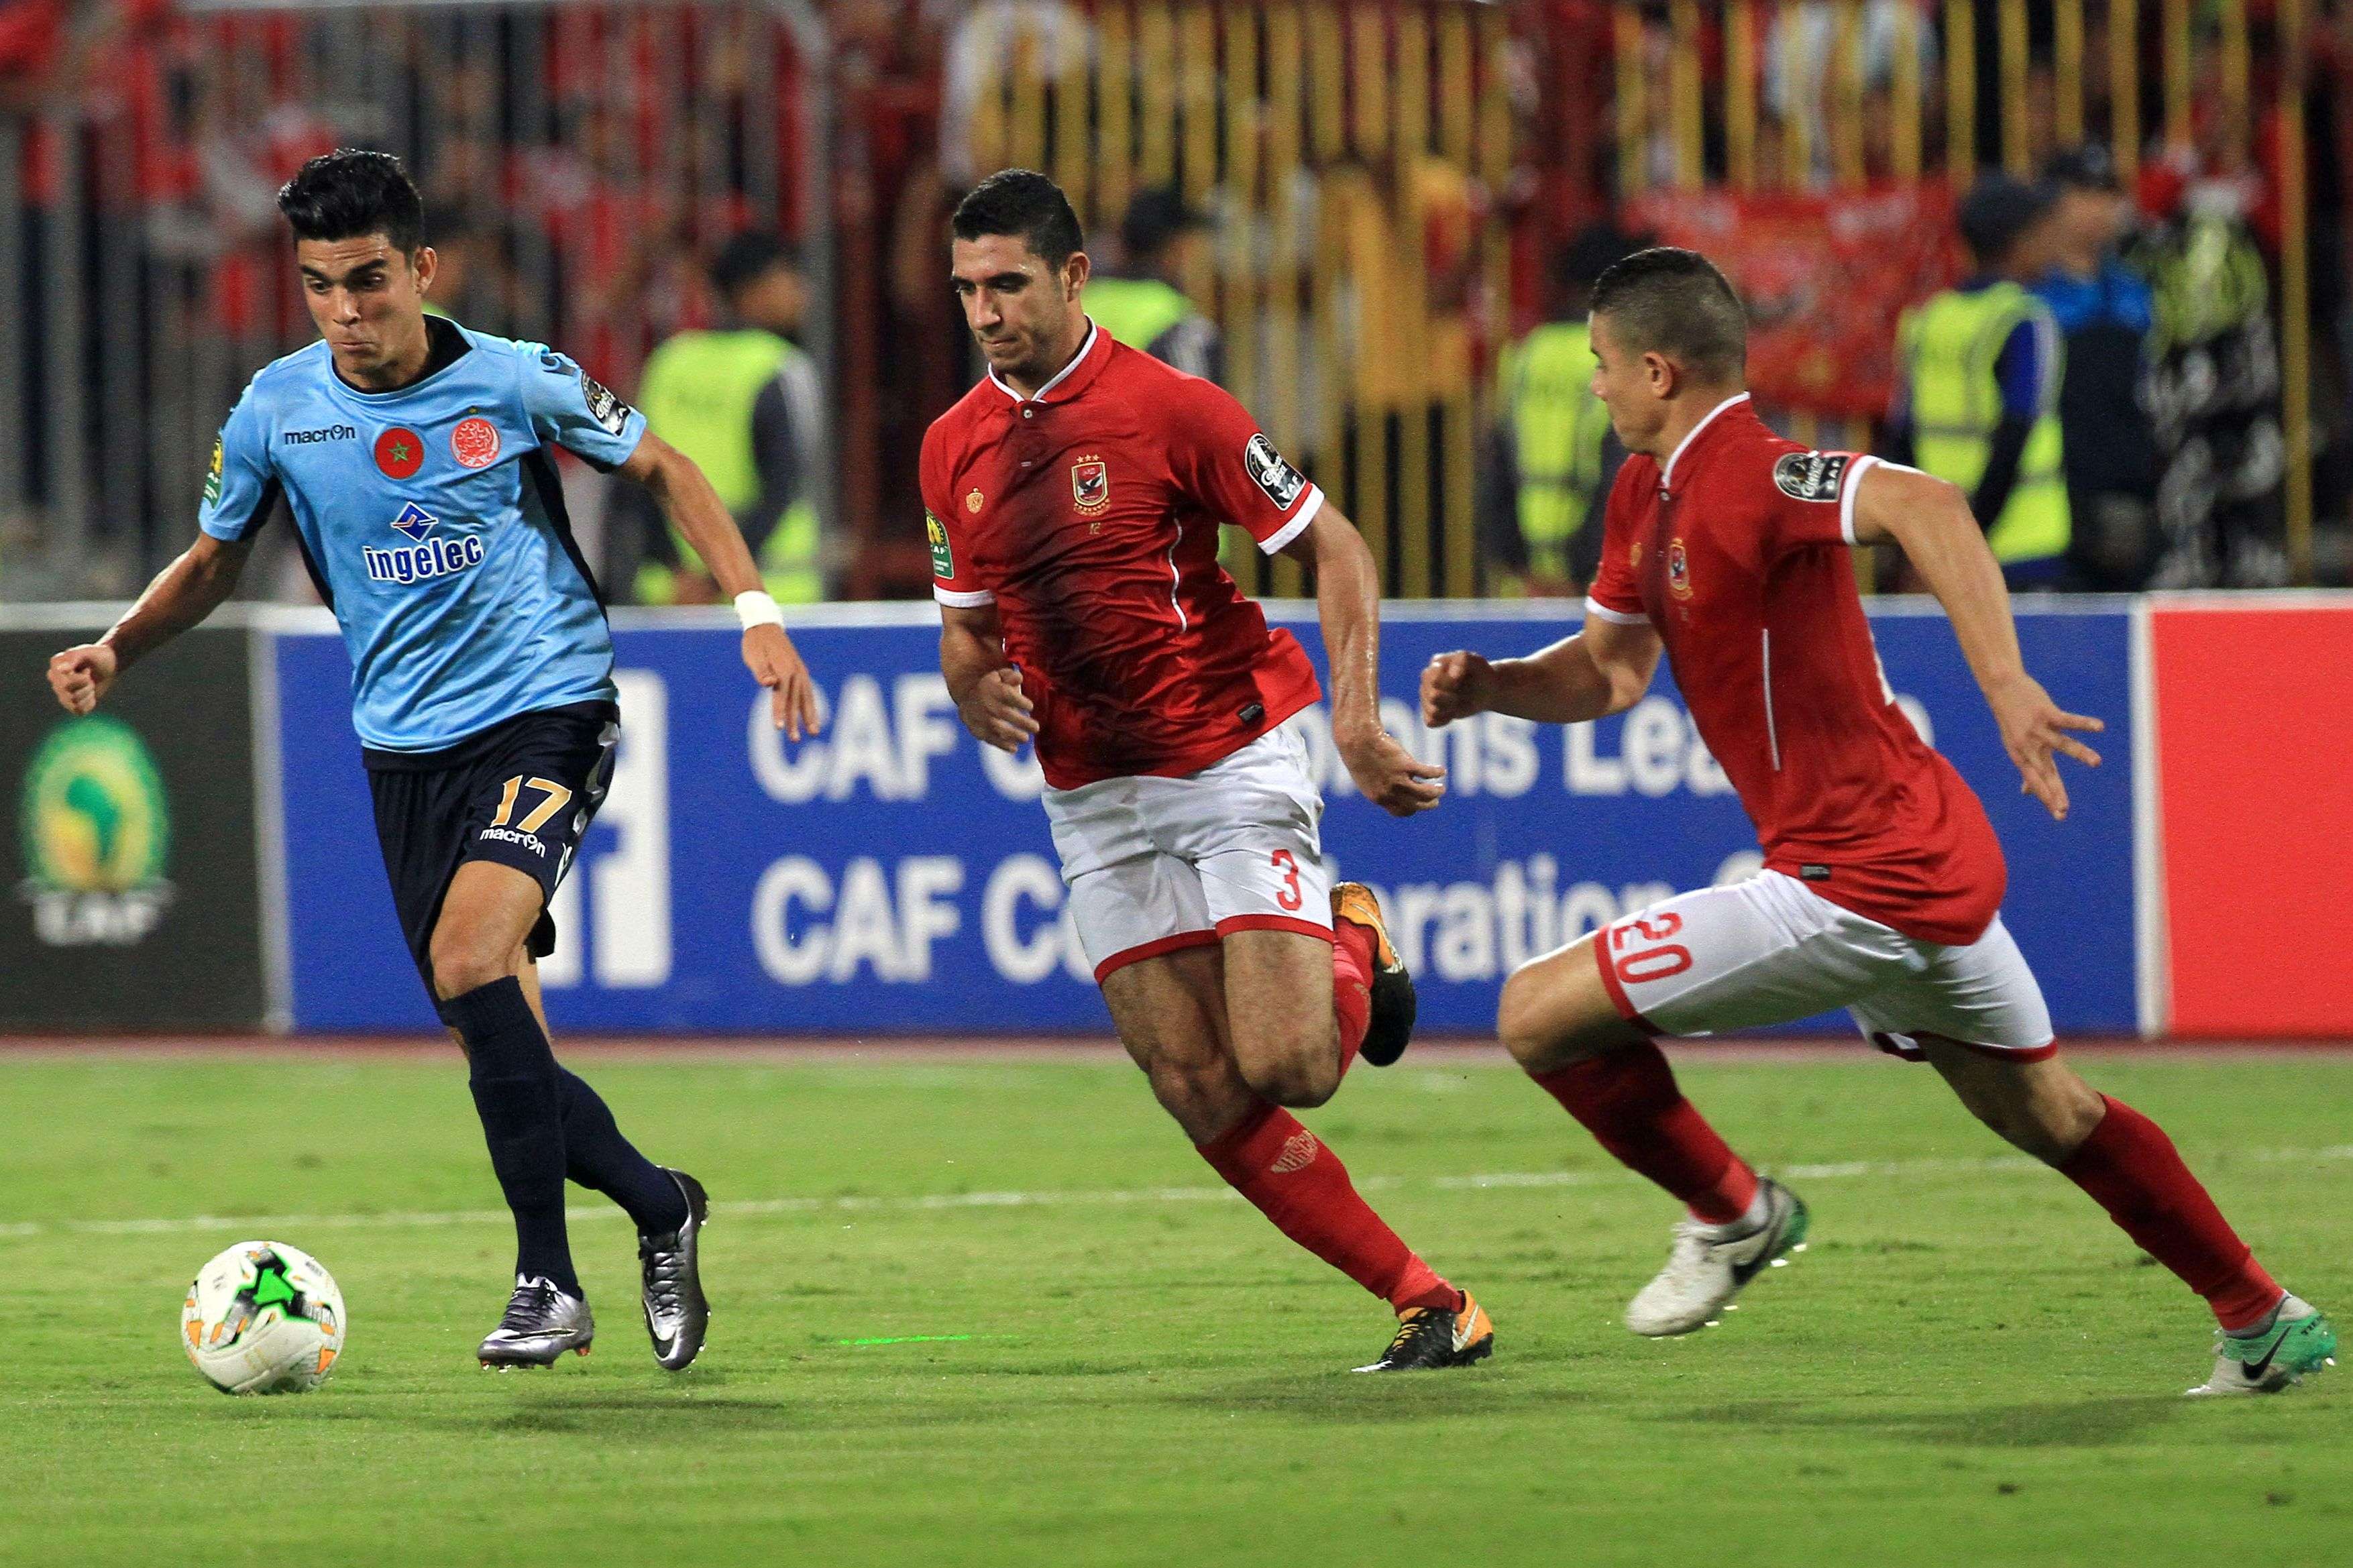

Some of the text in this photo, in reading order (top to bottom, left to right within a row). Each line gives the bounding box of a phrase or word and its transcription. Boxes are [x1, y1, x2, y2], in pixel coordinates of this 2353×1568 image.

[284, 425, 355, 445] macron
[362, 535, 484, 584] ingelec
[746, 672, 959, 803] CAF
[490, 774, 572, 834] 17
[479, 826, 547, 858] macron
[1272, 849, 1302, 911] 3
[749, 854, 966, 987] CAF
[1613, 911, 1694, 985] 20
